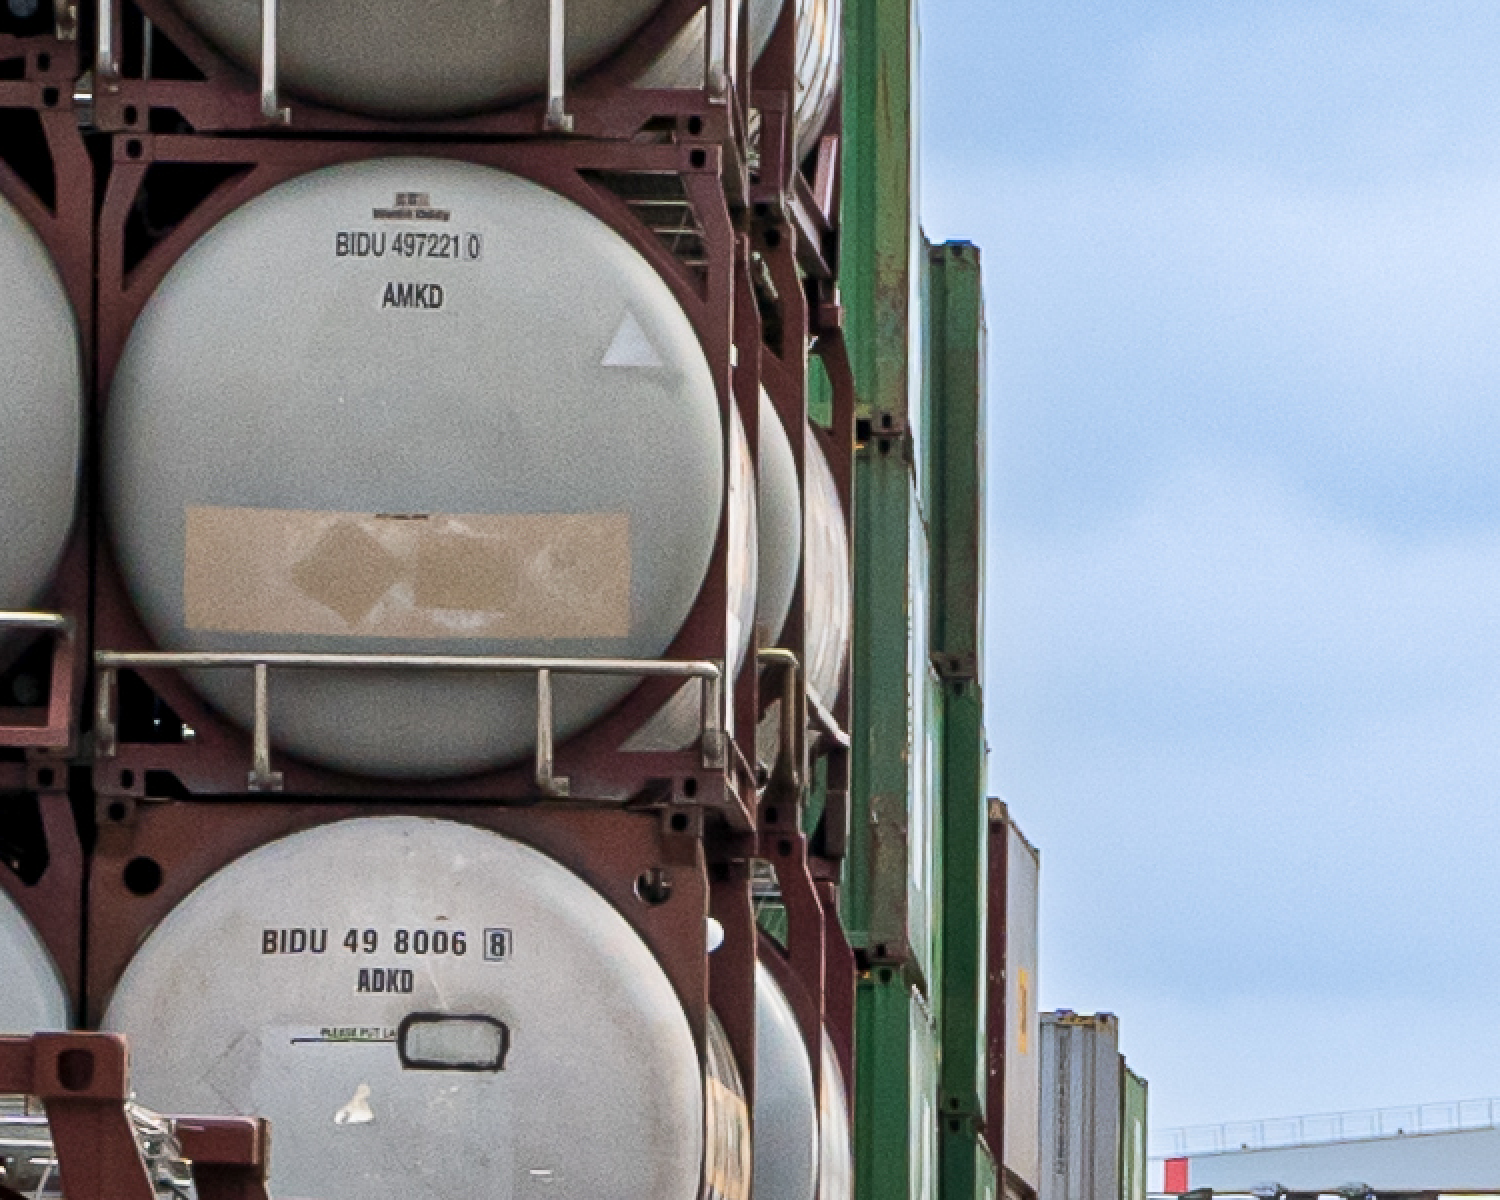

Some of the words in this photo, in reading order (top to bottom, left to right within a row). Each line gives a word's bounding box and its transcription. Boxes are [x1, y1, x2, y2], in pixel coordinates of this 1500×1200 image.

[336, 232, 386, 257] BIDU
[392, 232, 459, 258] 497221
[467, 233, 481, 260] 0
[382, 282, 444, 309] AMKD
[262, 928, 329, 955] BIDU
[343, 928, 378, 954] 49
[393, 929, 467, 956] 8006
[487, 930, 508, 958] 8
[357, 967, 414, 993] ADKD
